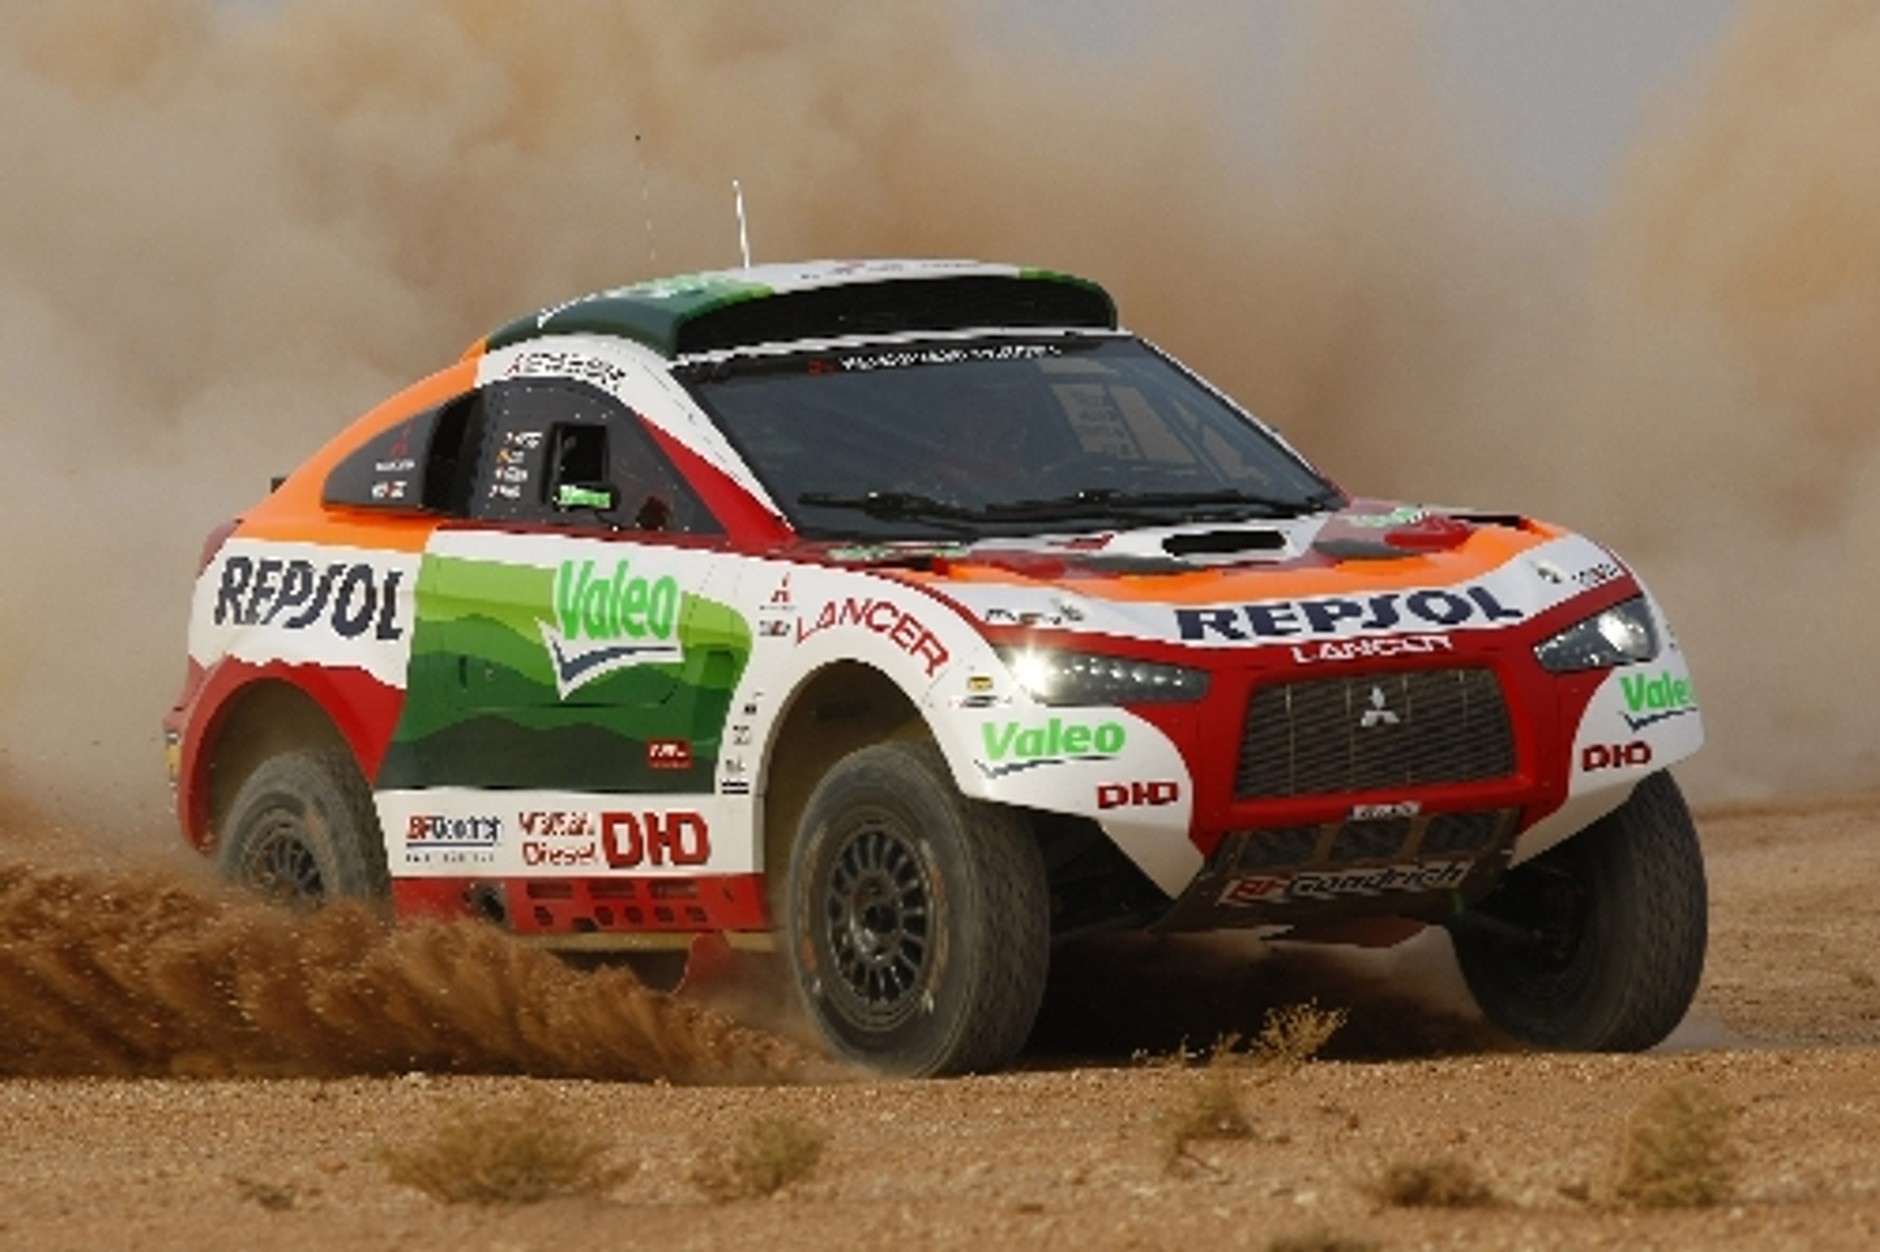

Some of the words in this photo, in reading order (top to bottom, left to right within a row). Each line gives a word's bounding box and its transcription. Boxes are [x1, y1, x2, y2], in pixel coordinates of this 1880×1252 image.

[213, 556, 404, 641] REPSOL
[559, 559, 678, 641] Valeo
[795, 597, 950, 678] LANCER
[1174, 586, 1524, 640] REPSOL
[981, 717, 1127, 762] Valeo
